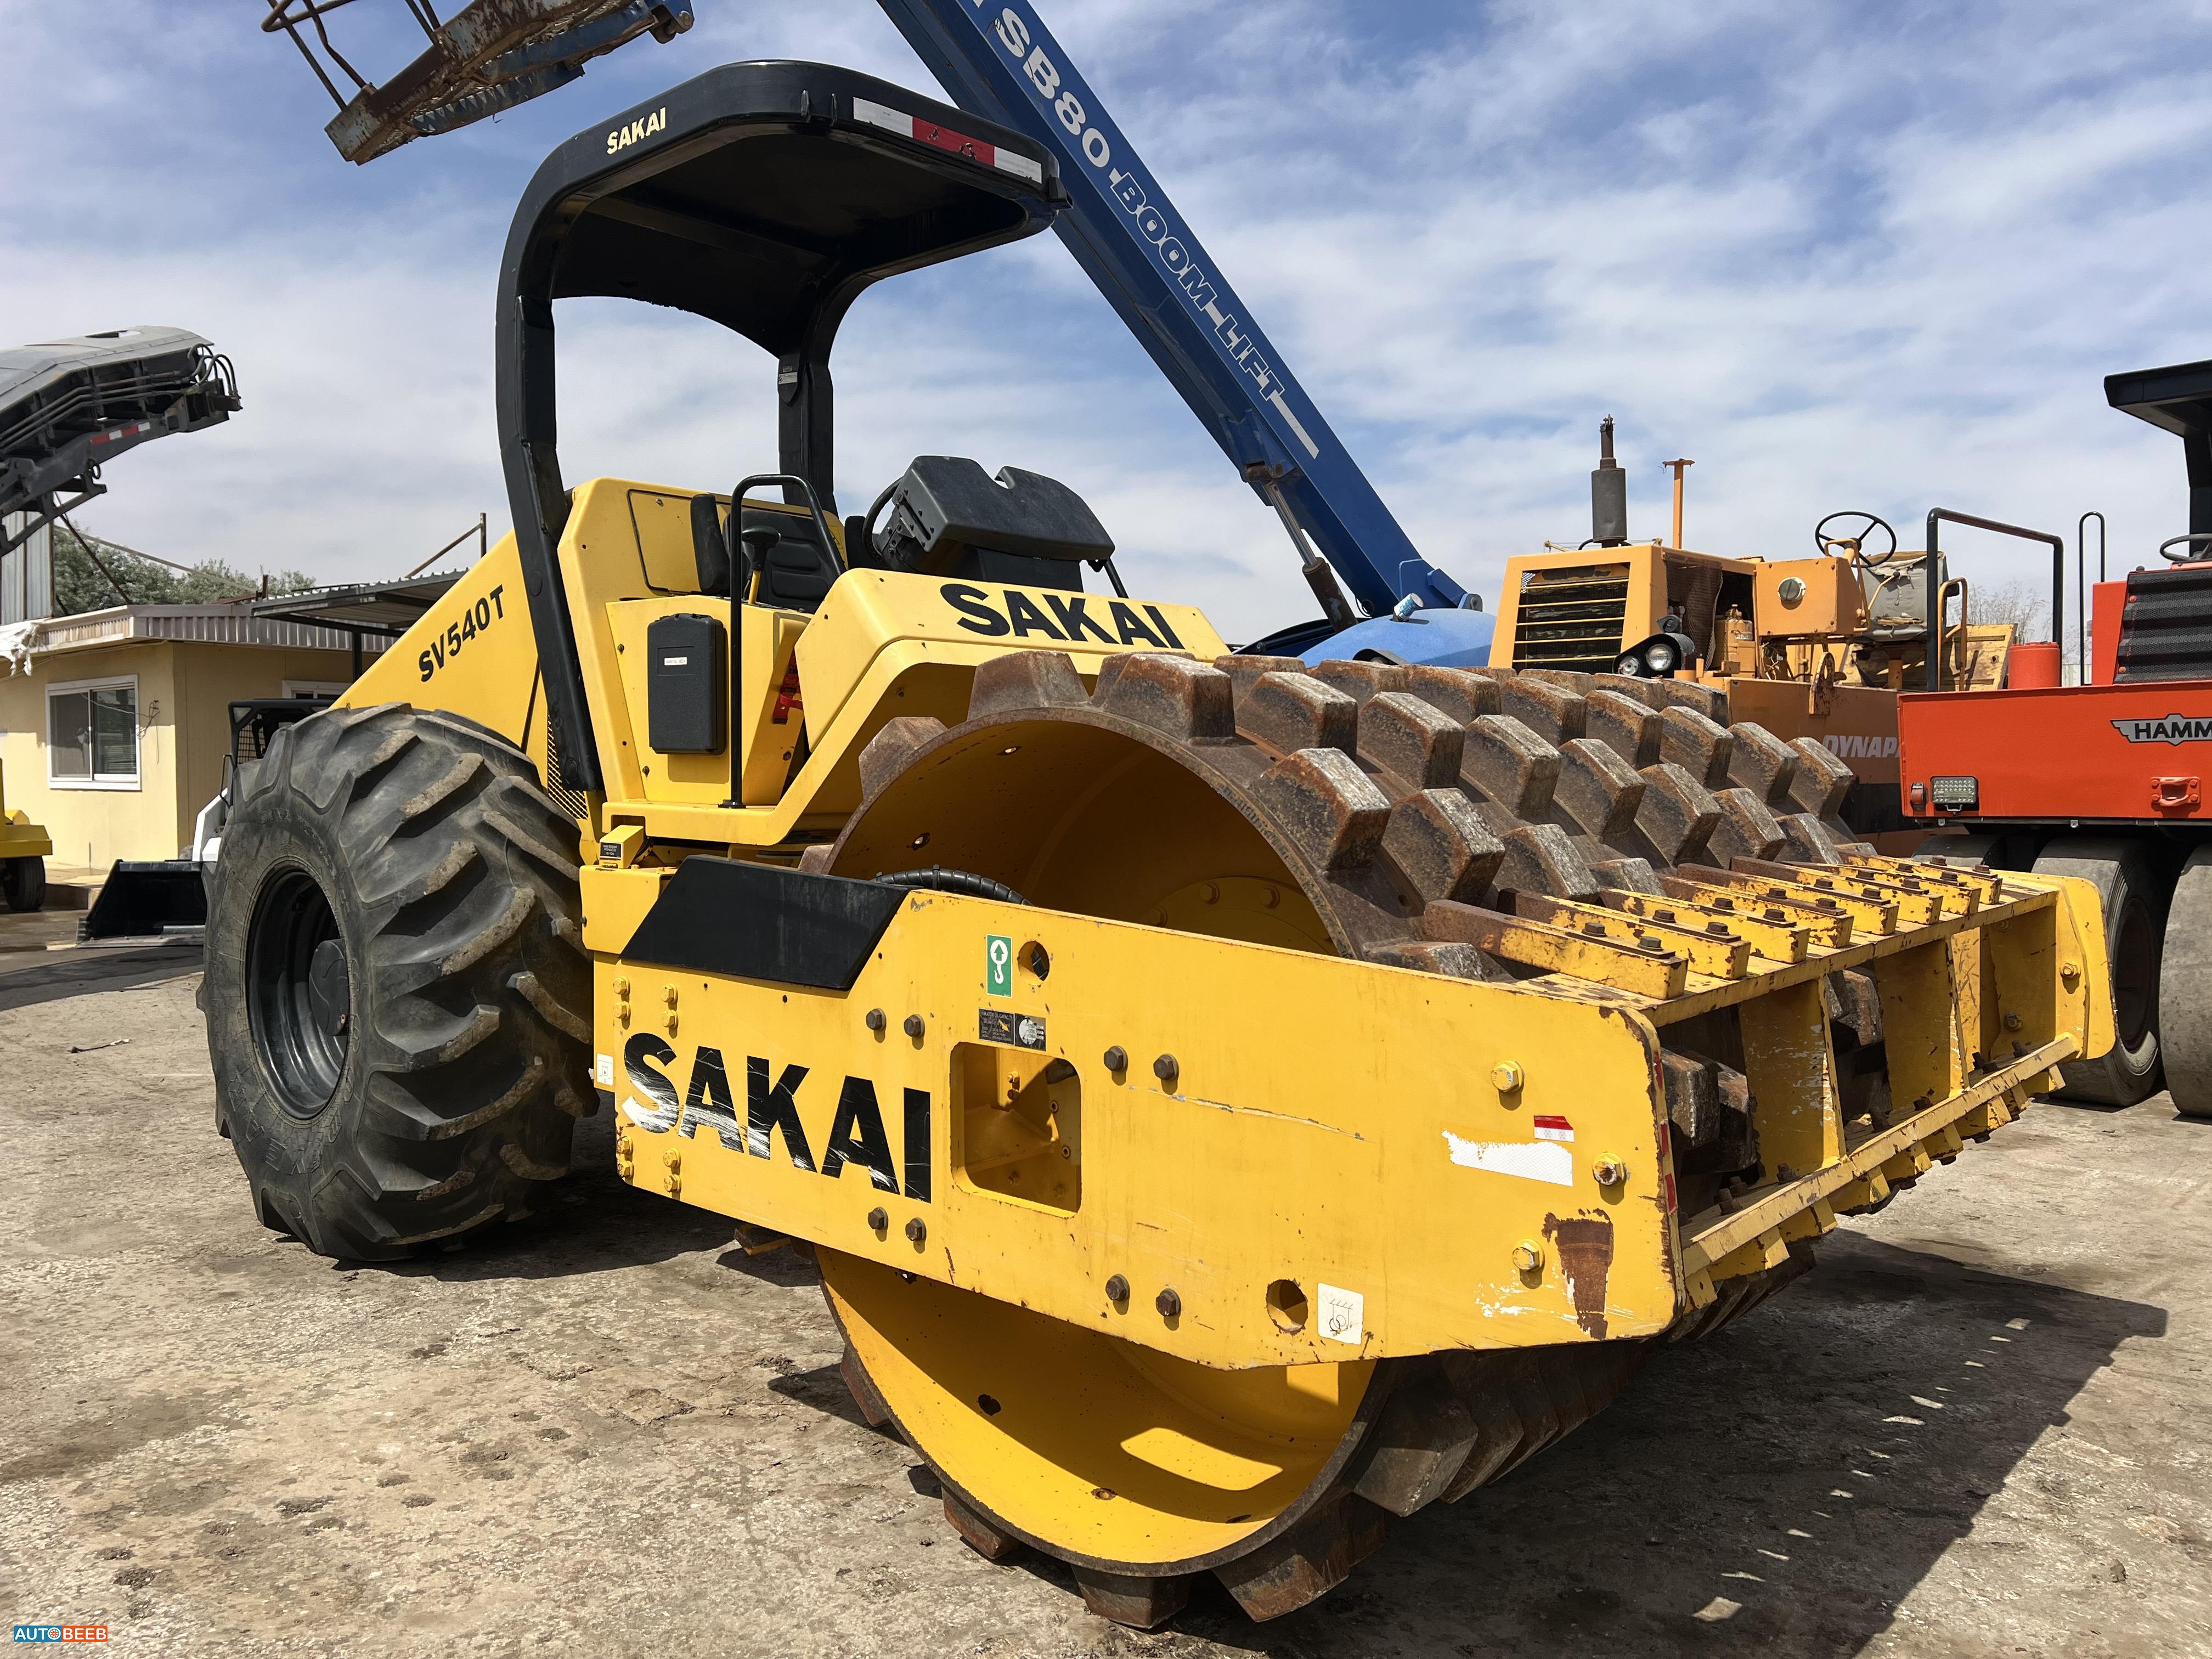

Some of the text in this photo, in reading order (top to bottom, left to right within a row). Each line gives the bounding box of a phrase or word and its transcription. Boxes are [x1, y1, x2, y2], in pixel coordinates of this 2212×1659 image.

[607, 106, 666, 154] SAKAI
[995, 8, 1285, 401] SB80 BOOM LIFT
[419, 584, 504, 682] SV540T
[940, 583, 1186, 650] SAKAI
[1822, 735, 1900, 758] DYNAP
[621, 1032, 932, 1204] SAKAI
